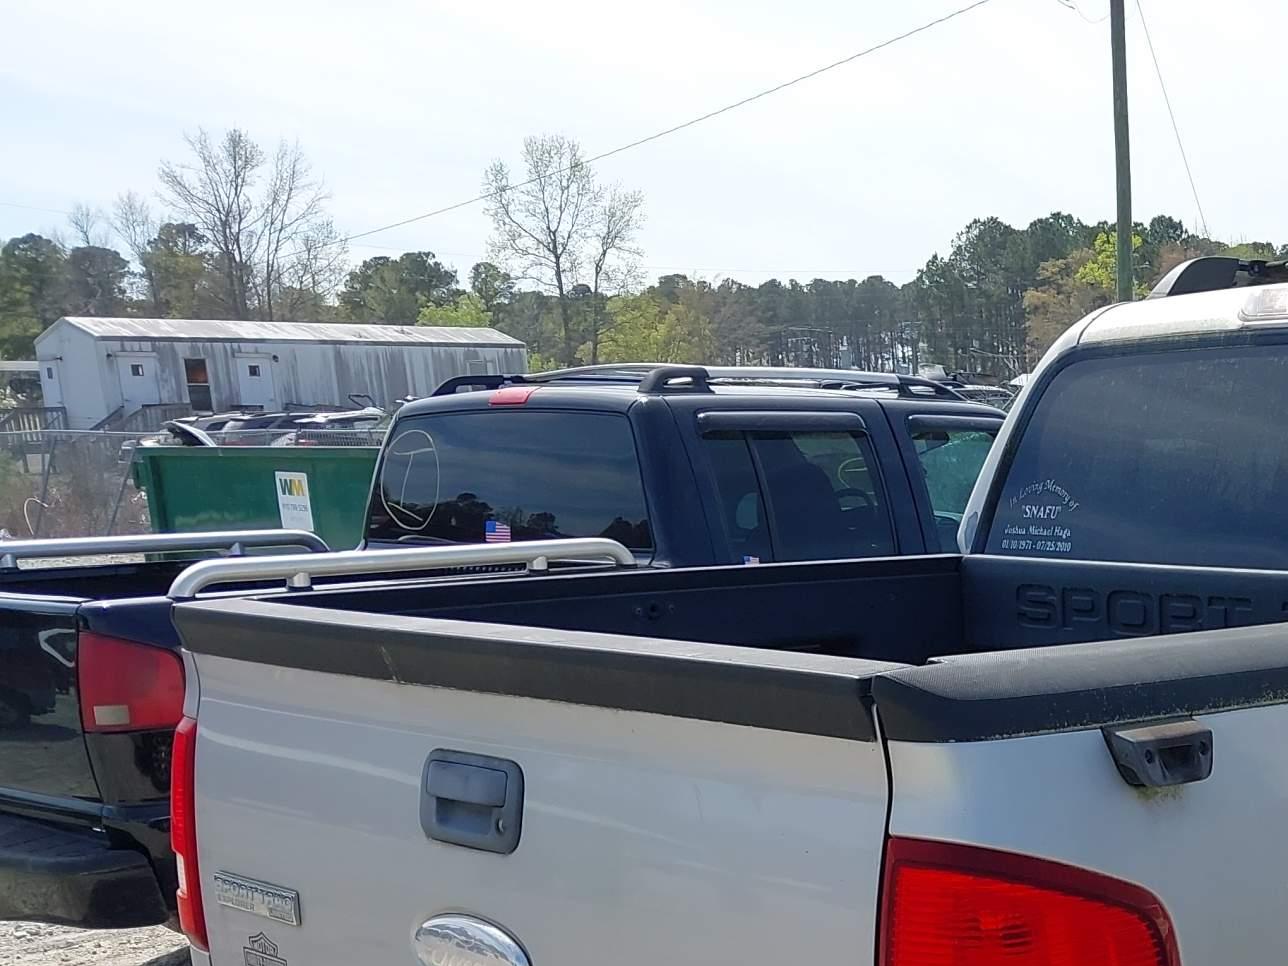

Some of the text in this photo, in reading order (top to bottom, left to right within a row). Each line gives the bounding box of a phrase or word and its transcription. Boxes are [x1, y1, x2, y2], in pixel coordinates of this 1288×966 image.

[279, 478, 305, 497] WM
[1019, 480, 1043, 501] Loving
[1044, 479, 1071, 505] Memory
[1069, 500, 1079, 512] of
[1004, 524, 1026, 535] Joshua
[1028, 525, 1053, 536] Michael
[1016, 583, 1252, 635] SPORT
